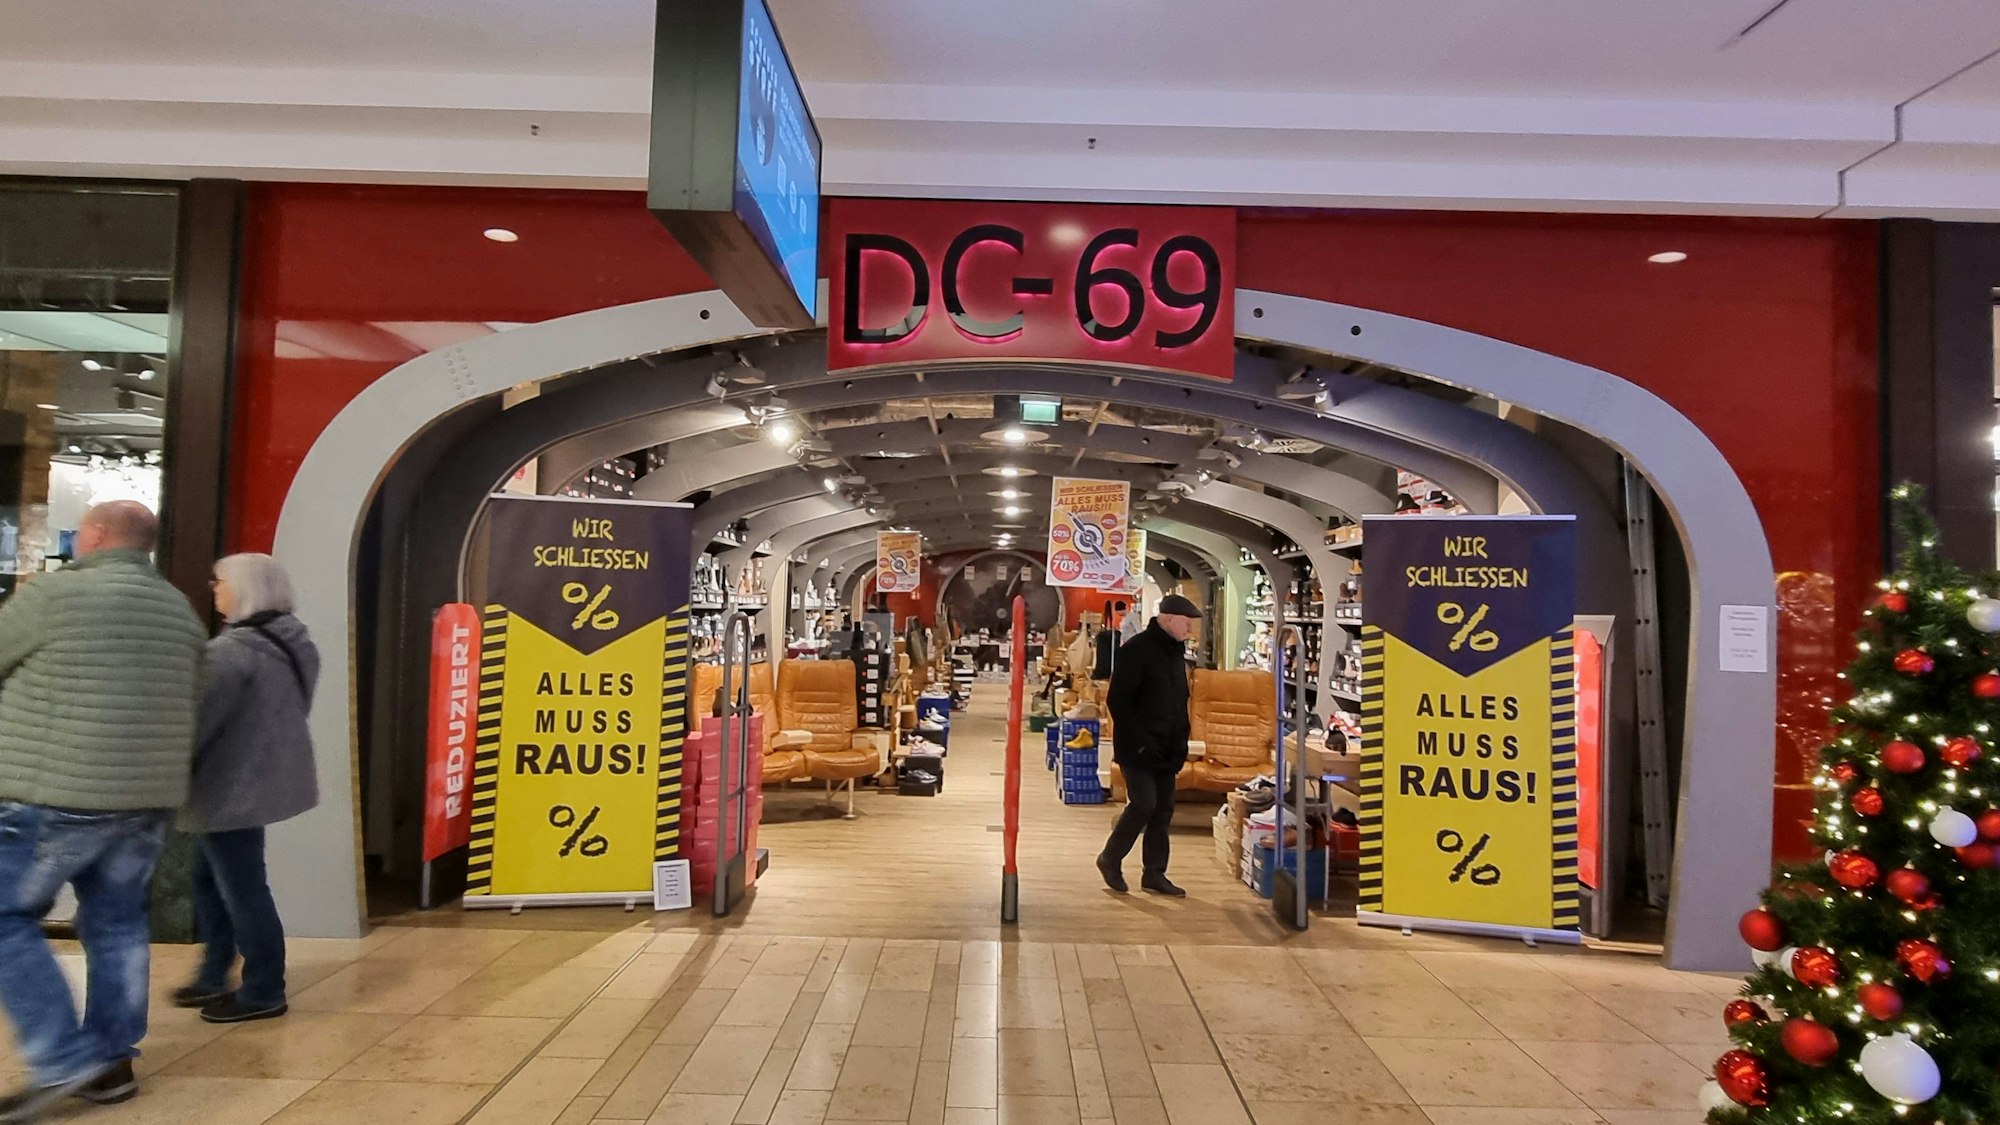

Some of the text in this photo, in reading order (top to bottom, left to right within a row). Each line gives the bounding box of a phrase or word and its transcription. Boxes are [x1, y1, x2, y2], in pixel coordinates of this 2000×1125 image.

[843, 224, 1222, 349] DC-69
[1057, 493, 1125, 506] ALLES MUSS
[572, 517, 614, 542] WIR
[533, 545, 649, 570] SCHLIESSEN
[1443, 535, 1488, 559] WIR
[1053, 560, 1080, 572] 70%
[1405, 565, 1528, 589] SCHLIESSEN
[536, 672, 634, 697] ALLES
[1416, 692, 1520, 721] ALLES
[445, 622, 470, 819] REDUZIERT
[535, 709, 632, 734] MUSS
[1417, 731, 1520, 760] MUSS
[514, 743, 647, 775] RAUS!
[1399, 764, 1536, 804] RAUS!
